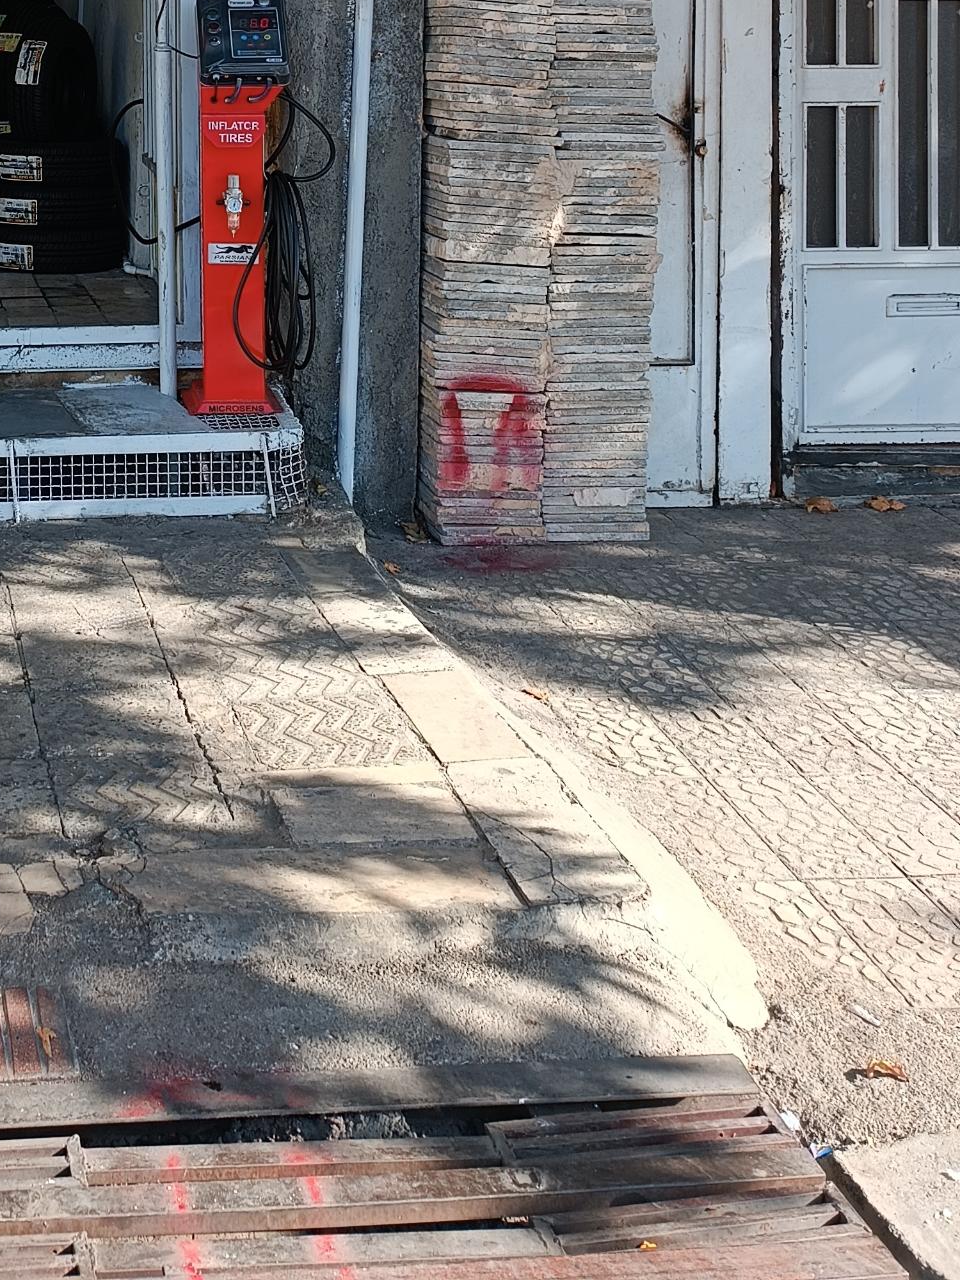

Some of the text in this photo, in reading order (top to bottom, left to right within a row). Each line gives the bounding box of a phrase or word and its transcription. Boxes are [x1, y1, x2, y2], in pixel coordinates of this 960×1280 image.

[208, 121, 260, 131] INFLATOR
[218, 133, 253, 143] TIRES
[208, 404, 265, 413] MICROSENS
